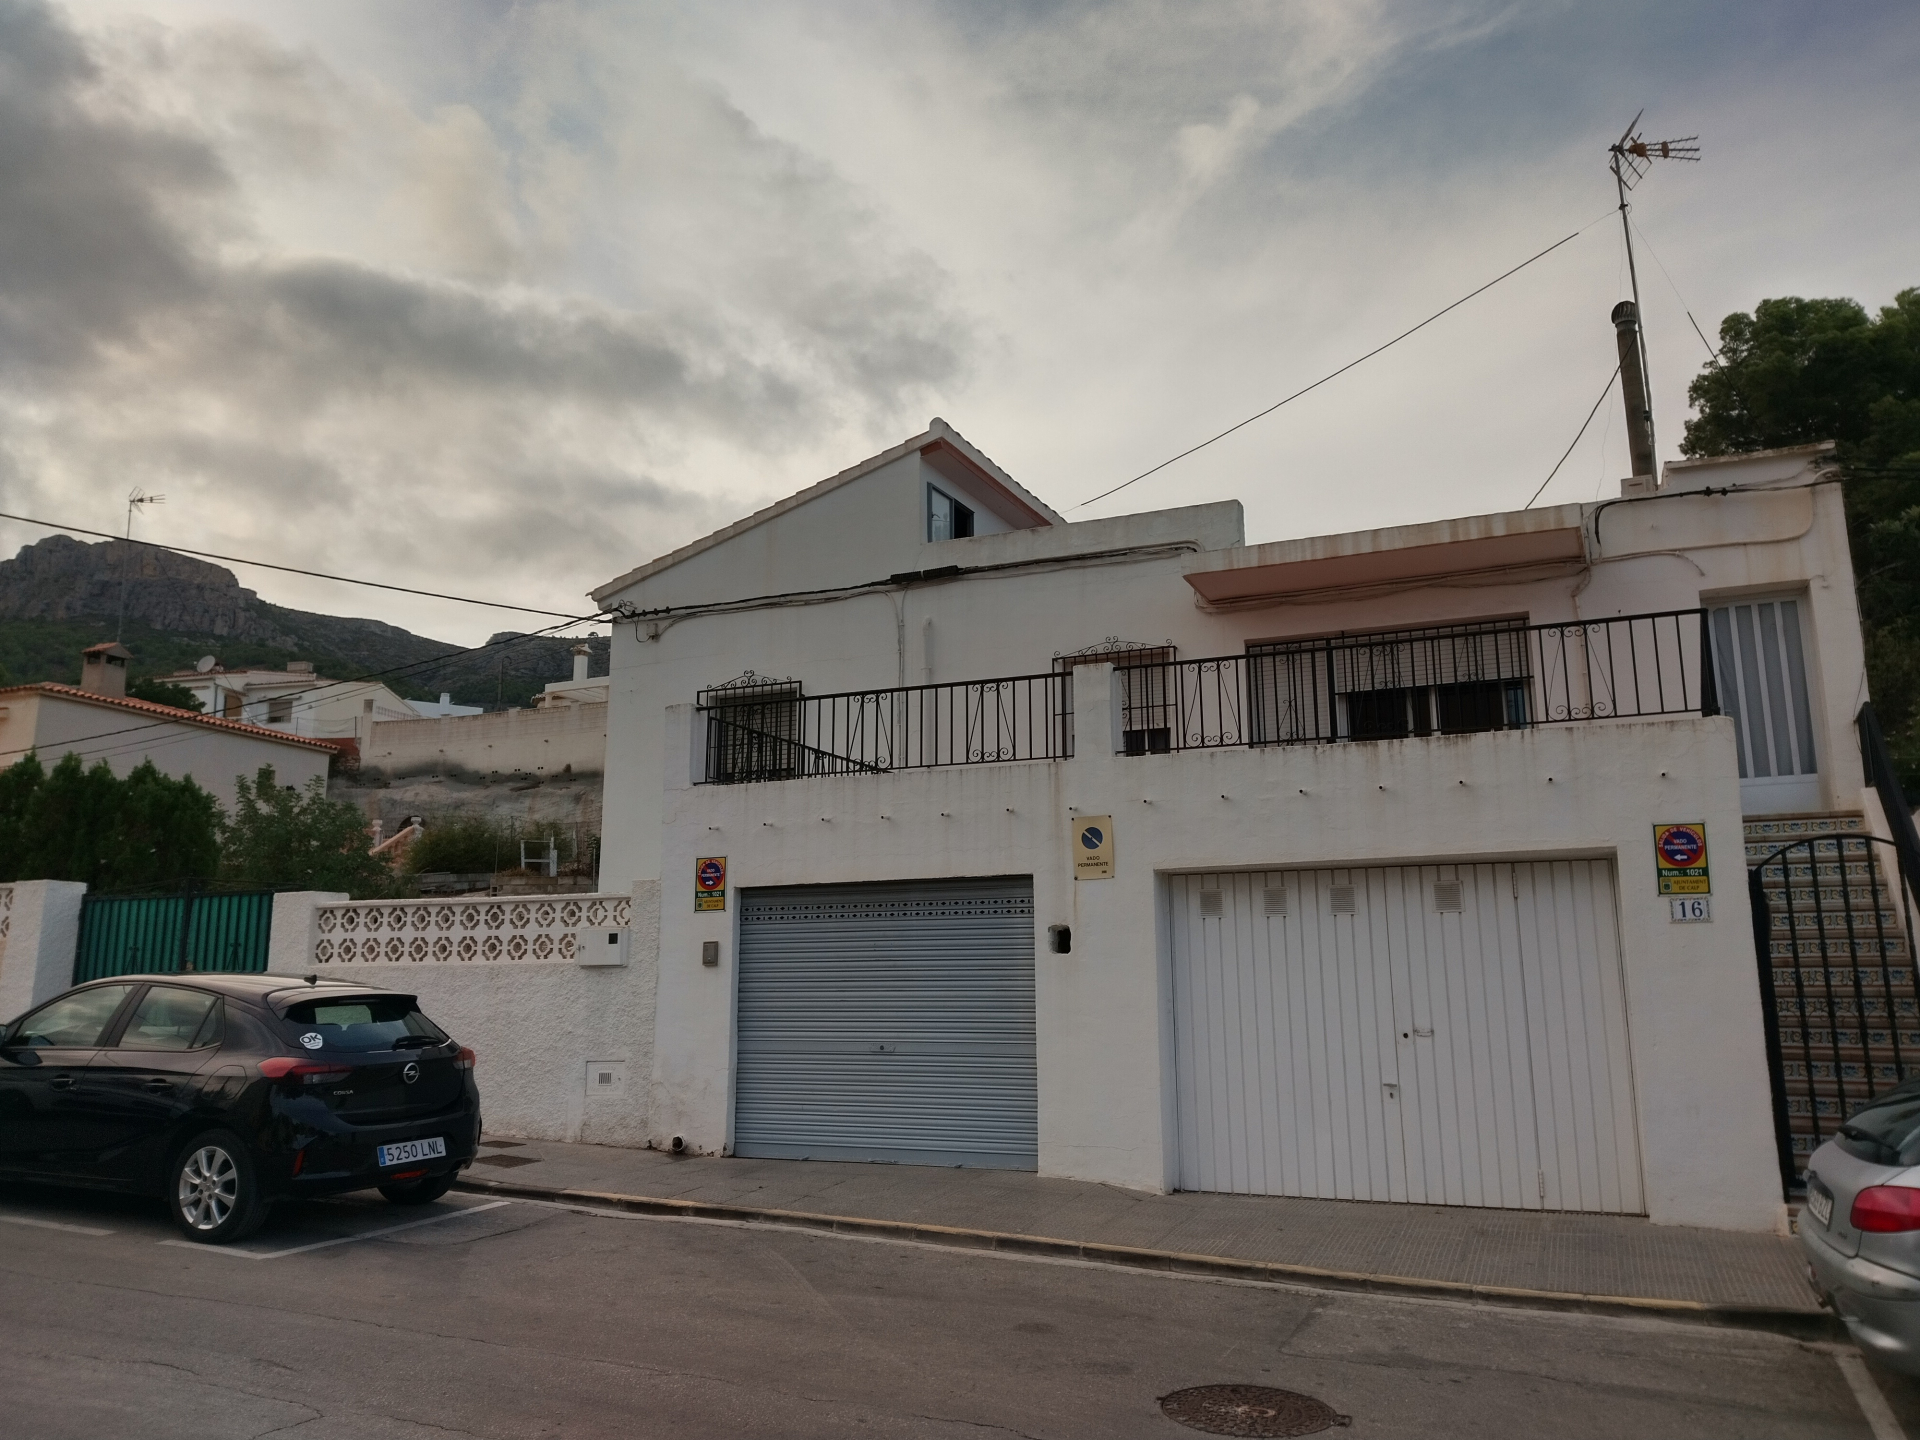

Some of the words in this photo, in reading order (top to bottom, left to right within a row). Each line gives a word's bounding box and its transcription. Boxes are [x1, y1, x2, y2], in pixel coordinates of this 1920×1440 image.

[1662, 869, 1684, 877] Num.:
[1686, 868, 1703, 876] 1021
[1679, 901, 1703, 918] 16
[301, 1033, 322, 1044] OK
[386, 1143, 418, 1162] 5250
[420, 1140, 442, 1157] LNL
